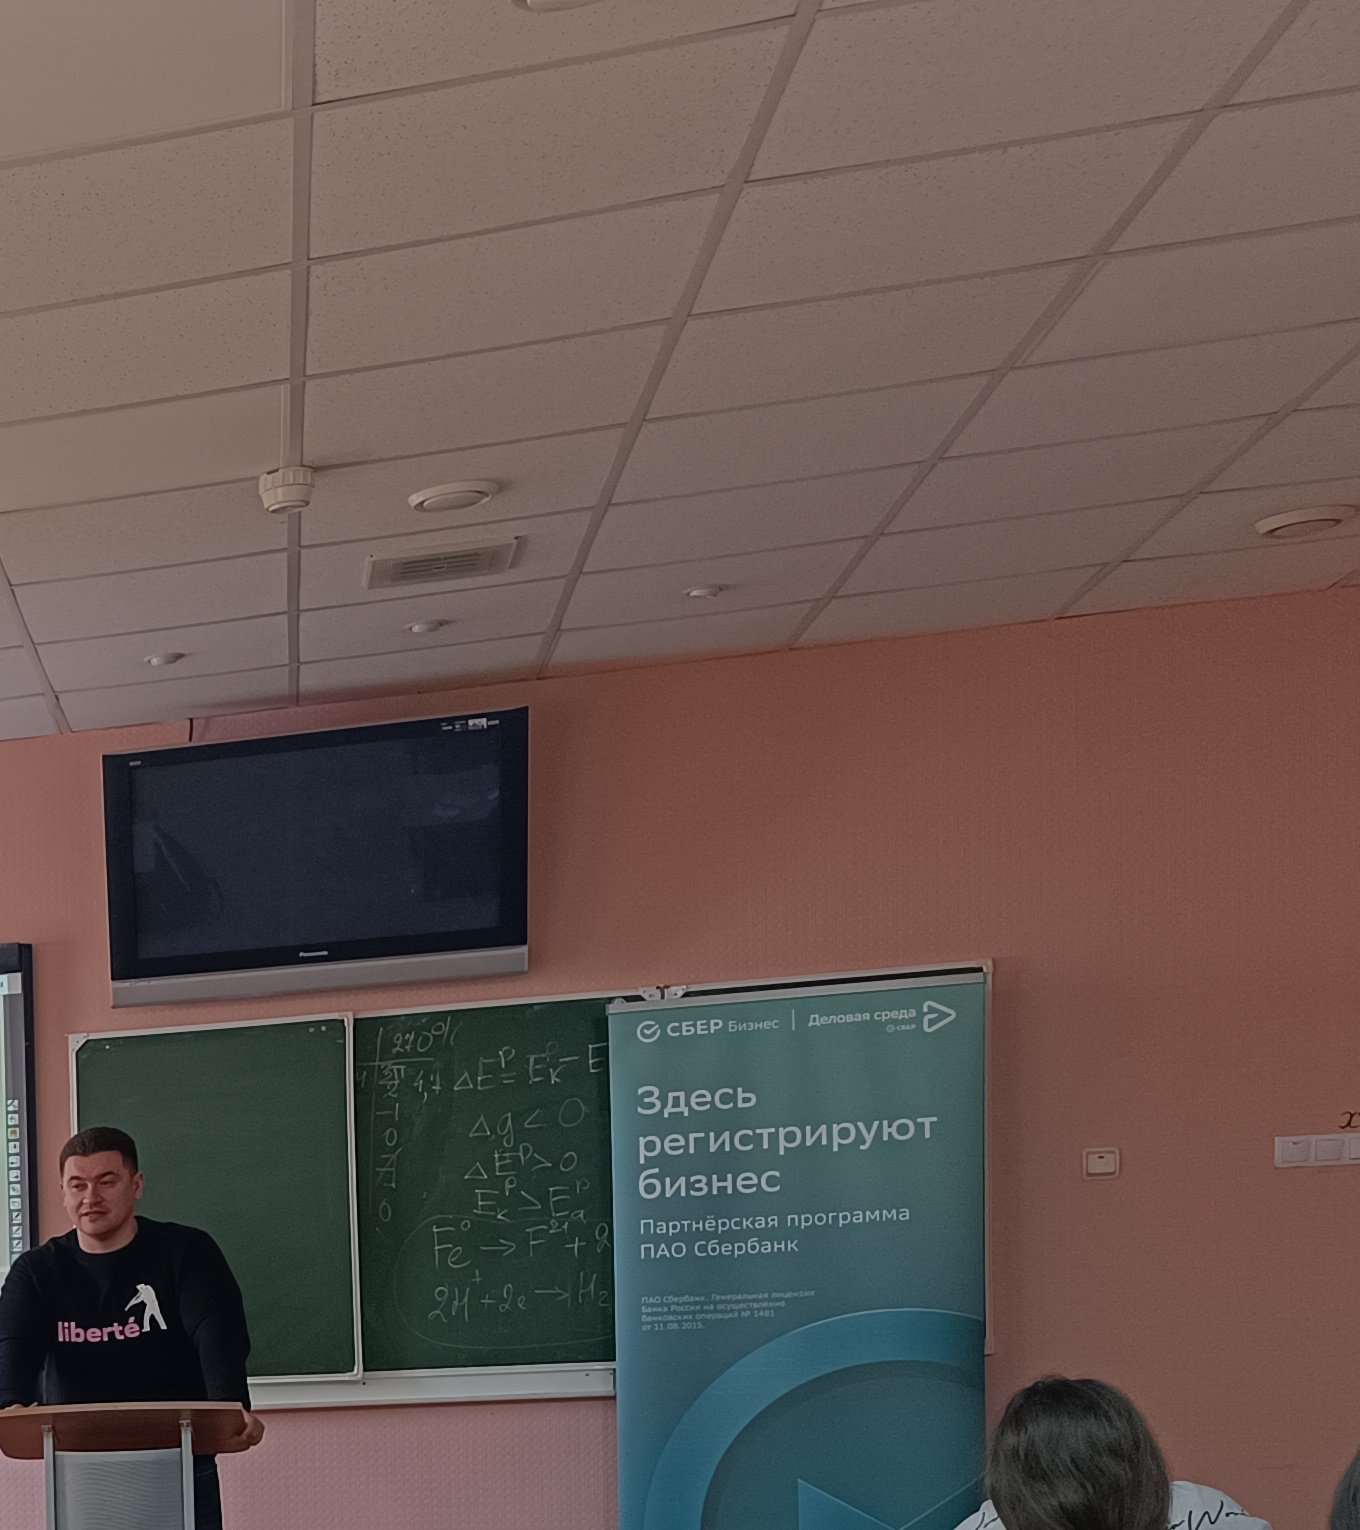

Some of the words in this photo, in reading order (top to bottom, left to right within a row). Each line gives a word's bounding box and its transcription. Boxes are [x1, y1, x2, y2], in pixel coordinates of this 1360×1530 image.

[666, 1019, 723, 1037] СБЕР
[728, 1018, 780, 1033] Бизнес
[807, 1012, 870, 1028] Деловая
[873, 1008, 917, 1022] среда
[636, 1084, 757, 1118] Здесь
[638, 1116, 938, 1164] регистрируют
[637, 1168, 781, 1200] бизнес
[640, 1213, 779, 1238] Партнёрская
[786, 1208, 911, 1231] программа
[640, 1242, 687, 1260] ПАО
[694, 1236, 799, 1259] Сбербанк
[641, 1296, 662, 1304] ПАО
[641, 1305, 668, 1313] Банка
[57, 1316, 141, 1343] liberté
